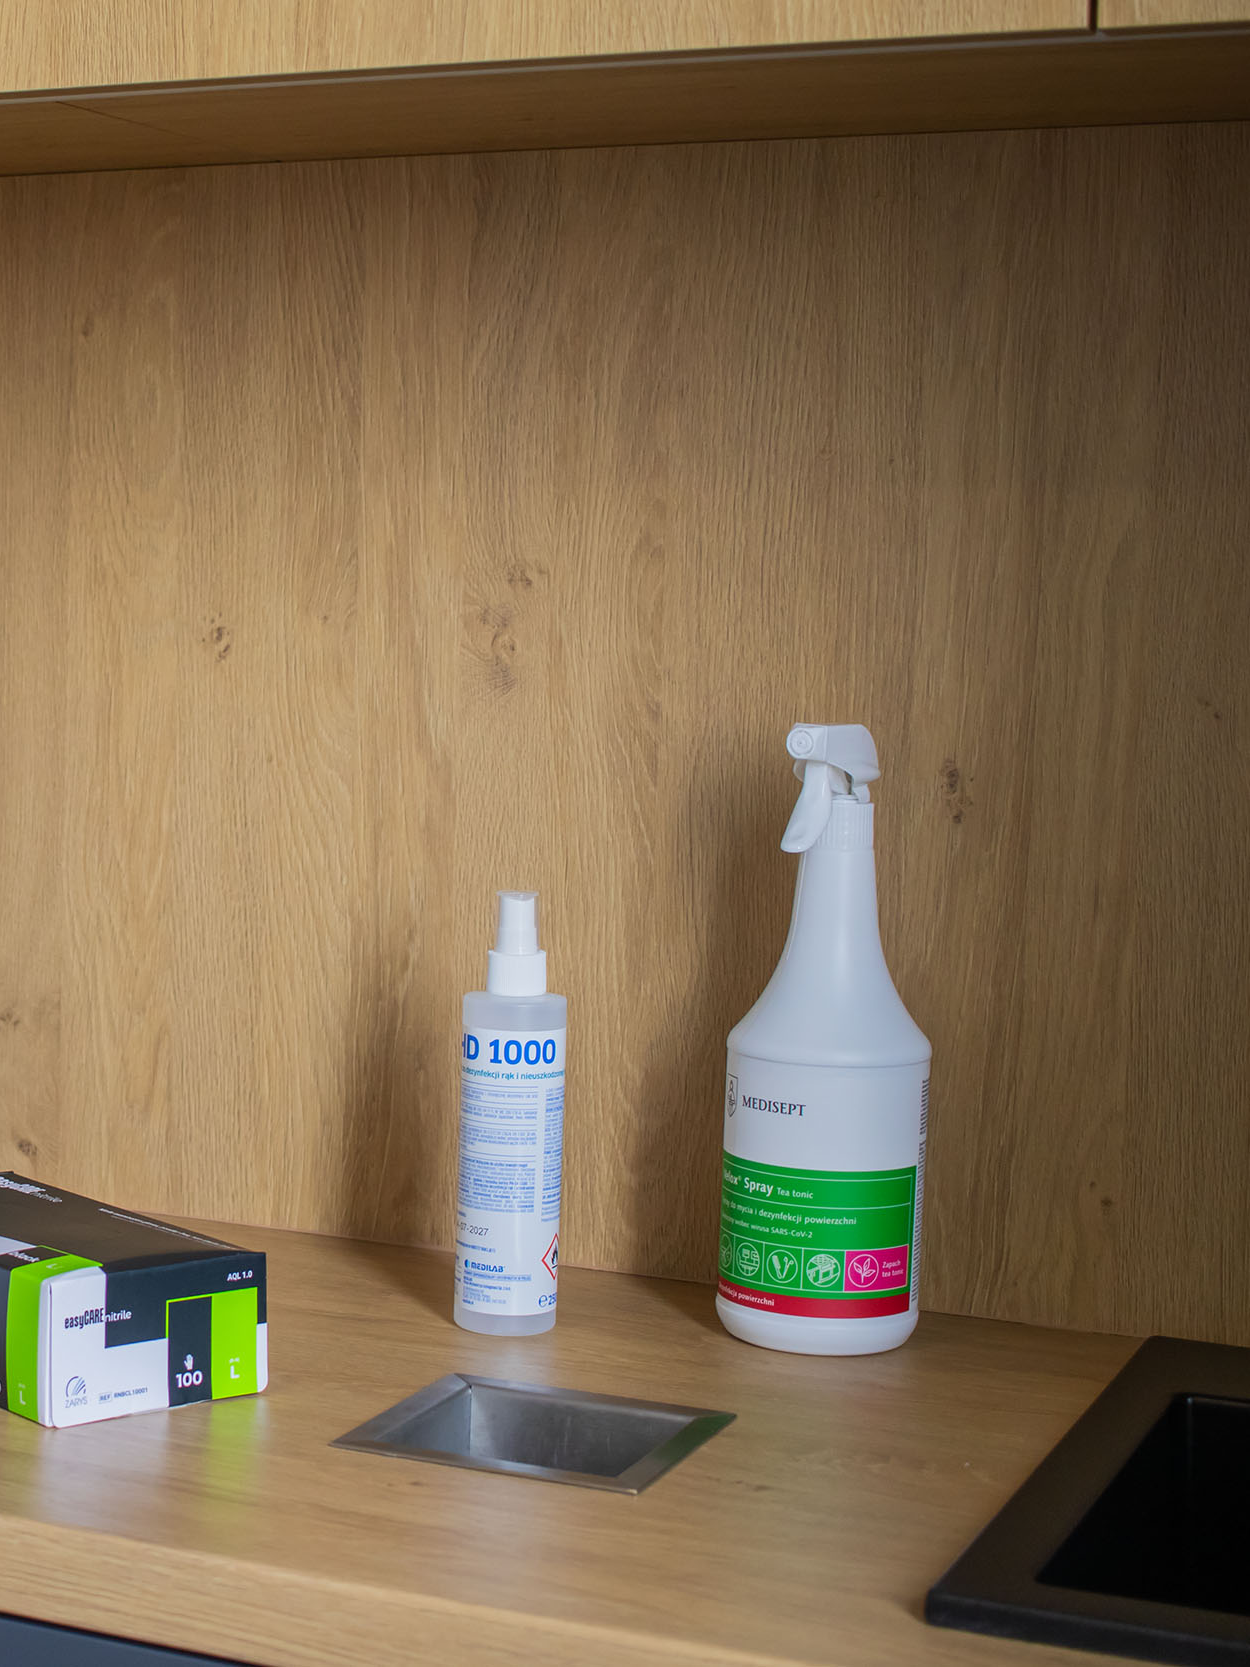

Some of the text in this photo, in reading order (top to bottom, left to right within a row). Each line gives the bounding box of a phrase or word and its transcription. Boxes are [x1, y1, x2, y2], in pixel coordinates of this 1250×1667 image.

[489, 1039, 556, 1065] 1000
[742, 1096, 806, 1116] MEDISEPT
[744, 1177, 774, 1197] Spray
[777, 1187, 790, 1197] Tea
[792, 1189, 814, 1199] tonic
[759, 1208, 802, 1224] dezynfekcji
[804, 1216, 857, 1225] powierzchni
[771, 1227, 813, 1239] SARS-CoV-2
[470, 1261, 504, 1273] MEDILAB
[882, 1260, 901, 1269] Zapach
[227, 1269, 253, 1281] AQL 1.0
[738, 1292, 775, 1306] powierzchni
[64, 1308, 132, 1329] easyCARE nitrile
[175, 1370, 203, 1388] 100
[230, 1365, 240, 1379] L
[19, 1390, 26, 1406] L
[65, 1396, 88, 1409] ZARYS
